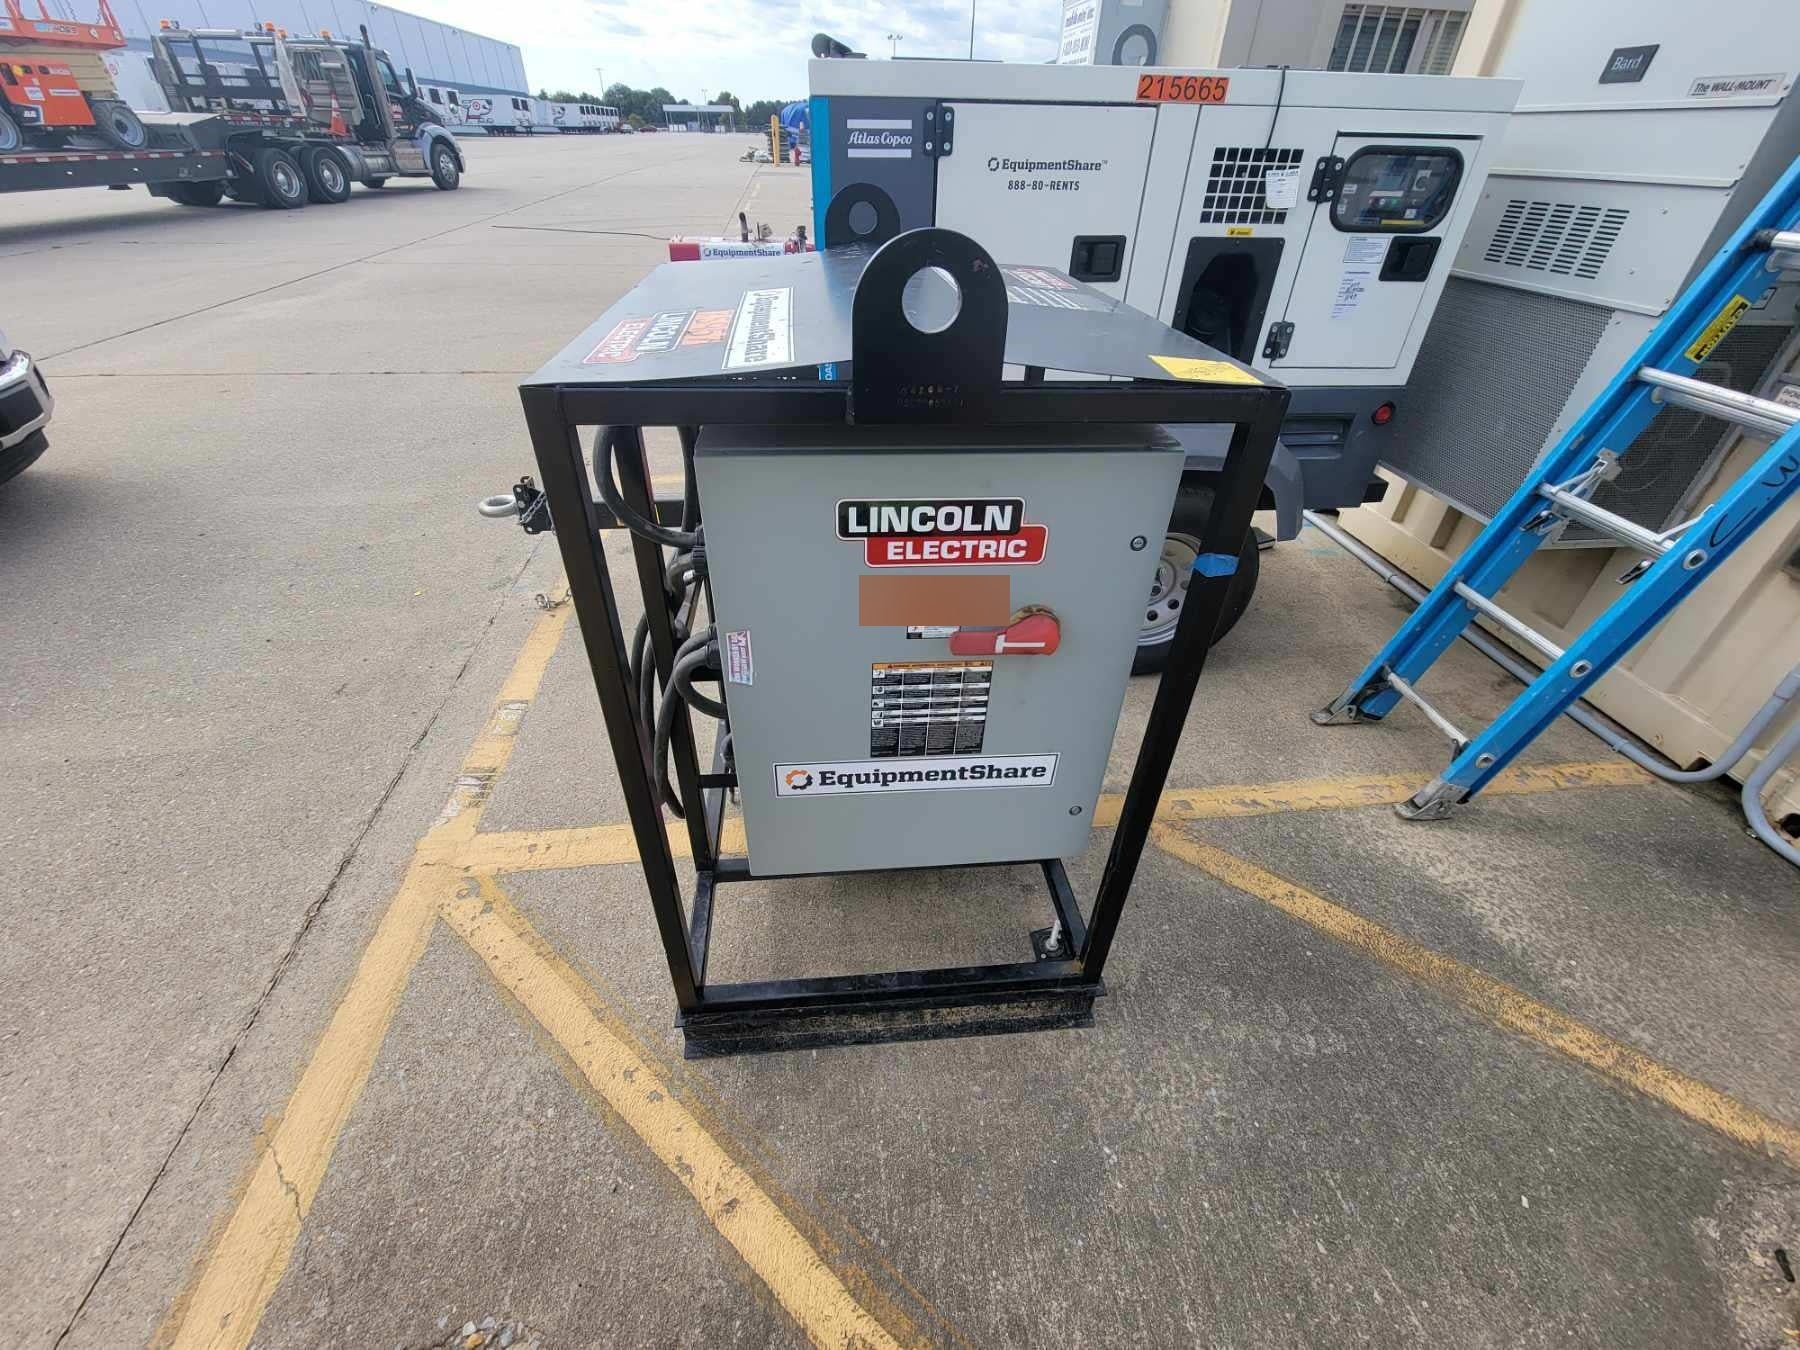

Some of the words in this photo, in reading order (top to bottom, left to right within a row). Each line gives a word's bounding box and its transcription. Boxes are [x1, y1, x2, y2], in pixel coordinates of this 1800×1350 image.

[1611, 55, 1644, 71] Bard
[1138, 75, 1227, 101] 215665
[1693, 83, 1710, 94] The
[1710, 80, 1773, 92] WALL-MOUNT
[848, 131, 880, 146] Atlas
[881, 131, 913, 147] Copco
[1007, 180, 1081, 192] 888-80-RENTS
[712, 248, 781, 258] EquipmentShare
[848, 505, 1014, 533] LINCOLN
[887, 539, 1028, 561] ELECTRIC
[818, 764, 1047, 788] EquipmentShare
